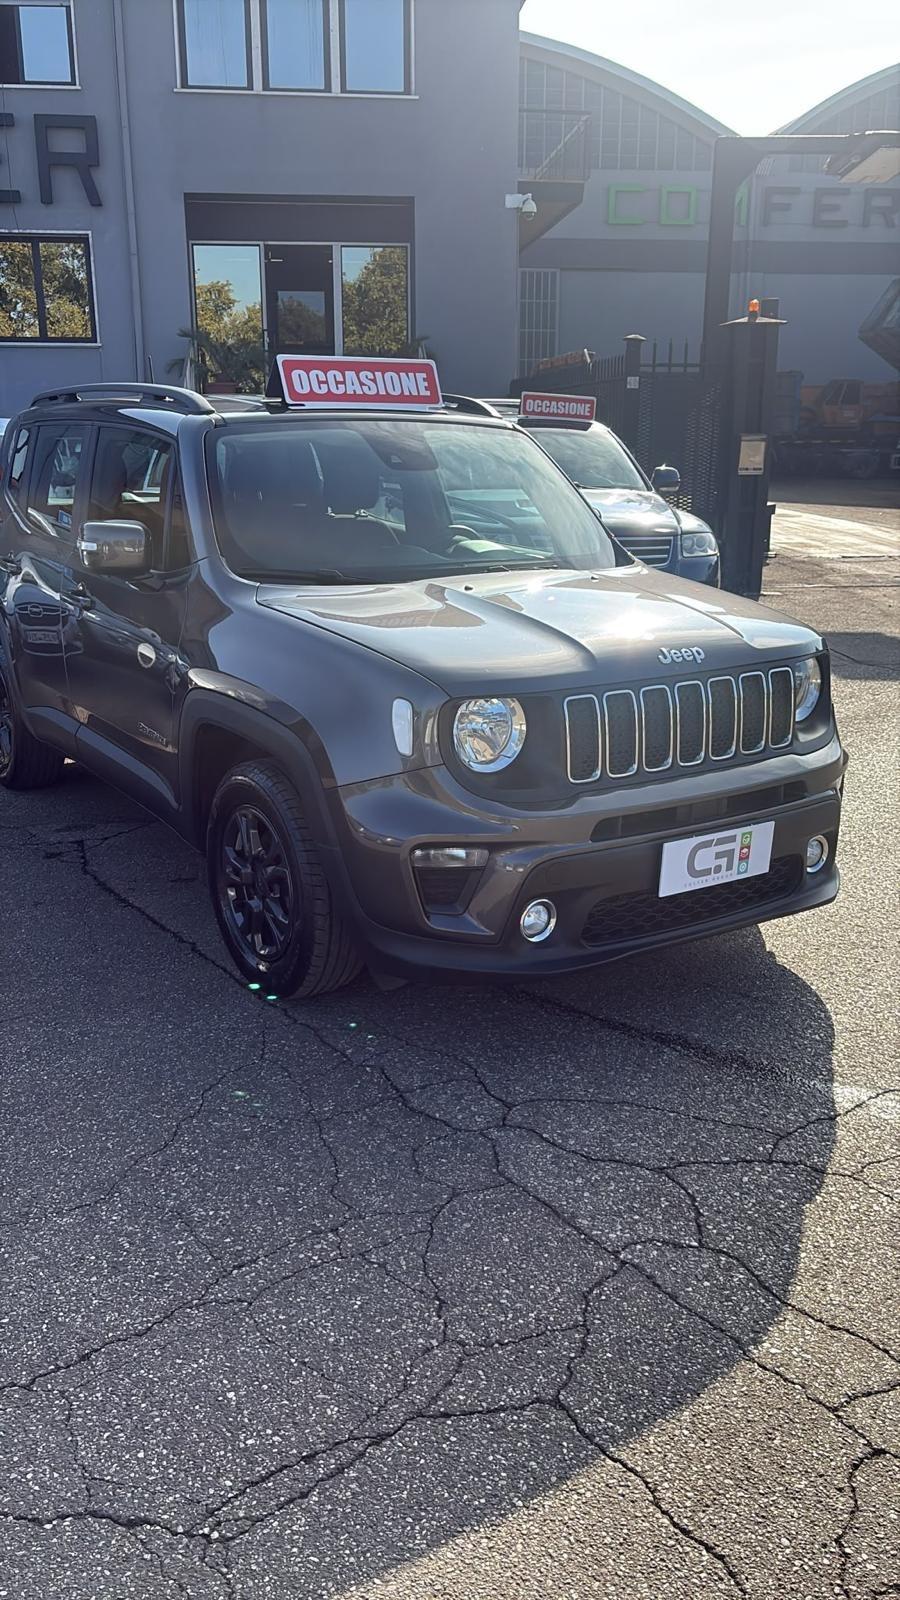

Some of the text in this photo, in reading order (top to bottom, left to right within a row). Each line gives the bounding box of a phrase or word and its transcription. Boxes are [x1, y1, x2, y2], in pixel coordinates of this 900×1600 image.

[291, 369, 431, 396] OCCASIONE
[526, 399, 591, 416] OCCASIONE
[658, 646, 705, 664] Jeep
